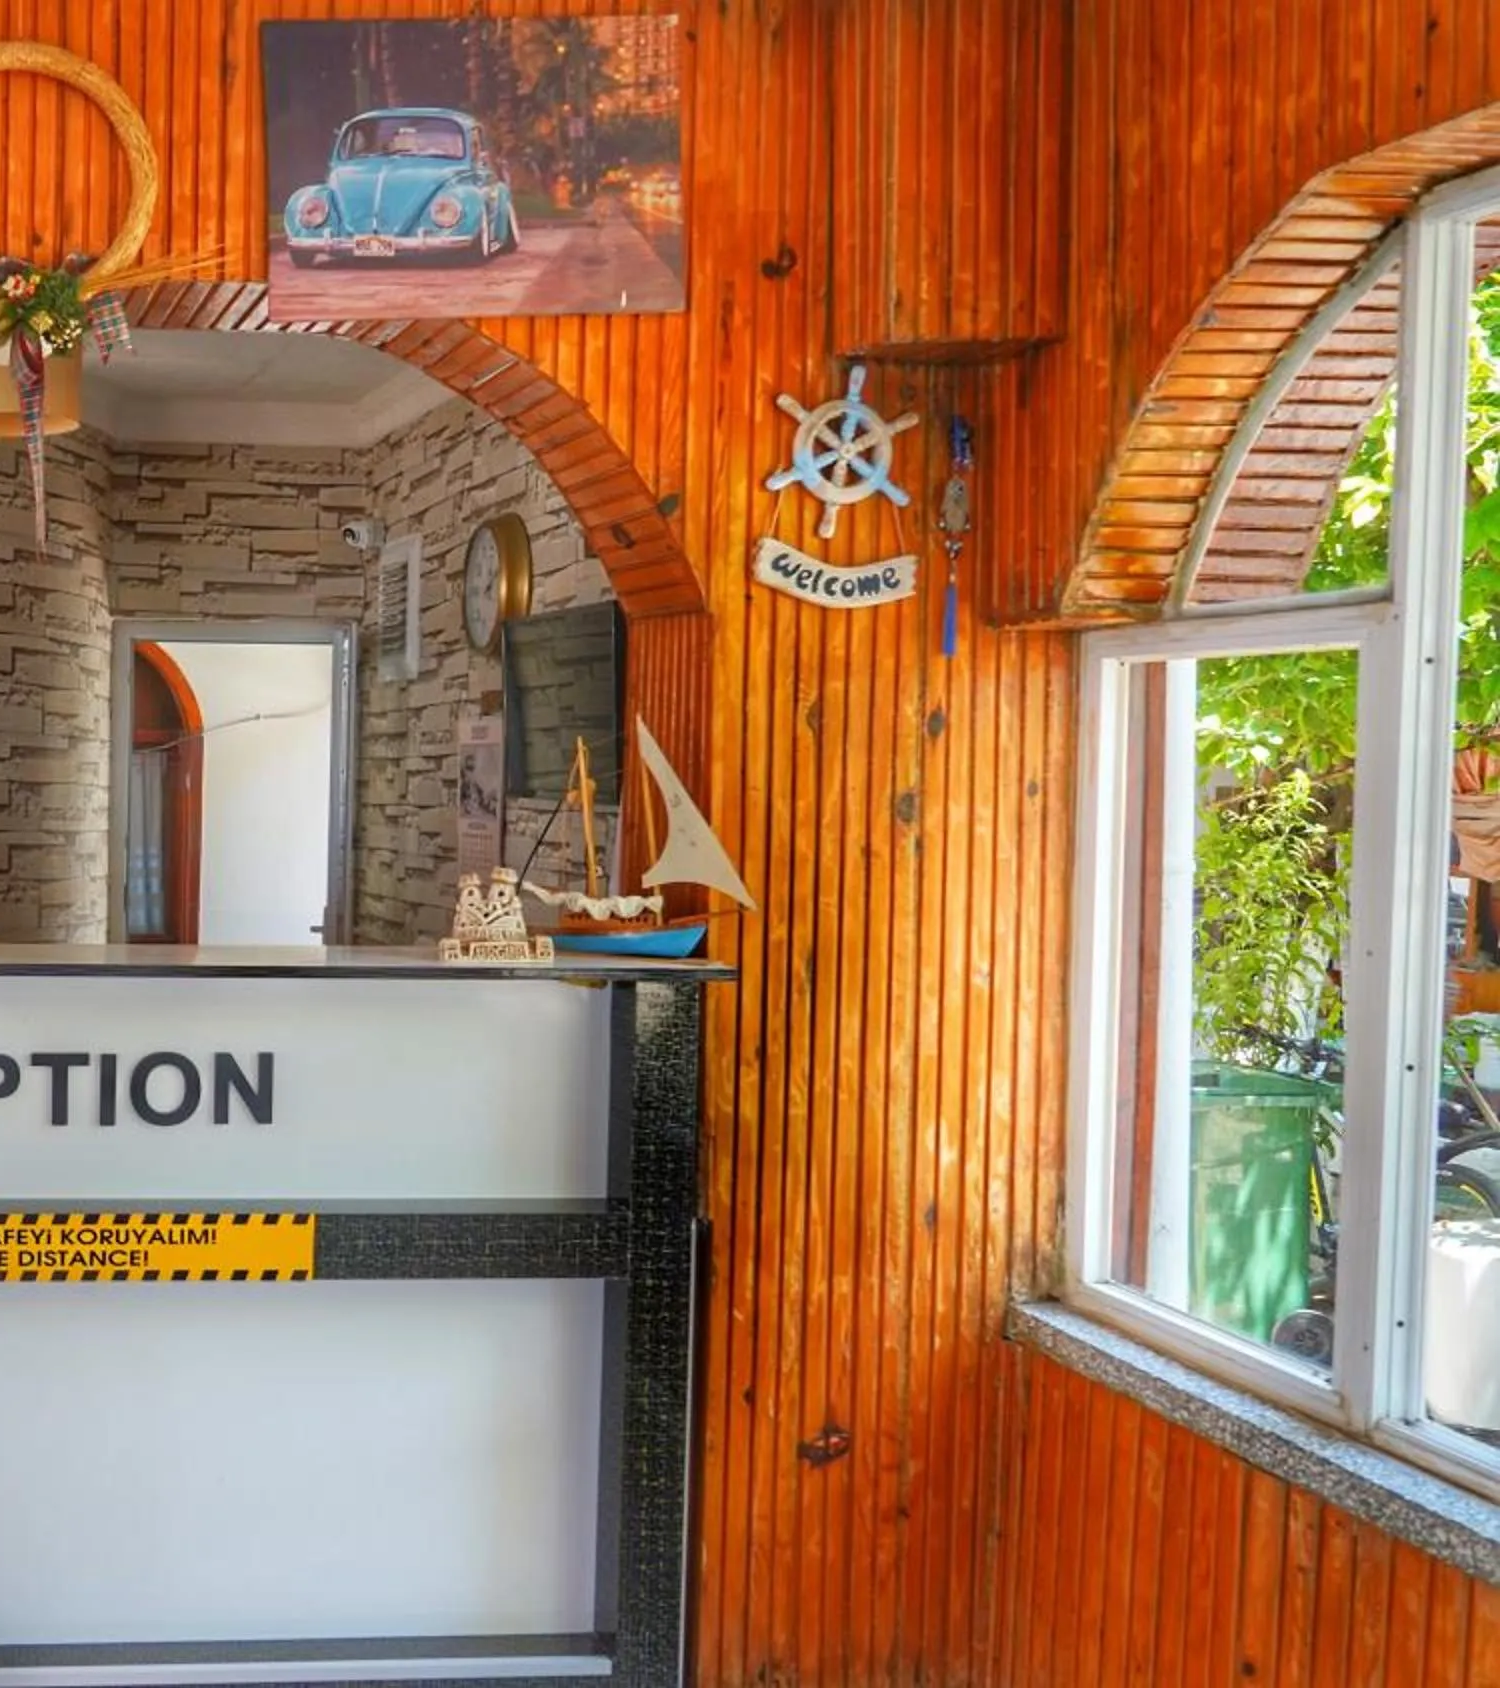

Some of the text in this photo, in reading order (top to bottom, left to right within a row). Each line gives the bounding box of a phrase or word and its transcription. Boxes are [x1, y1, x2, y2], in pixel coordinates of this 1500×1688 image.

[771, 553, 900, 597] welcome
[60, 1228, 218, 1246] KORUYALIM!
[17, 1249, 149, 1267] DISTANCE!
